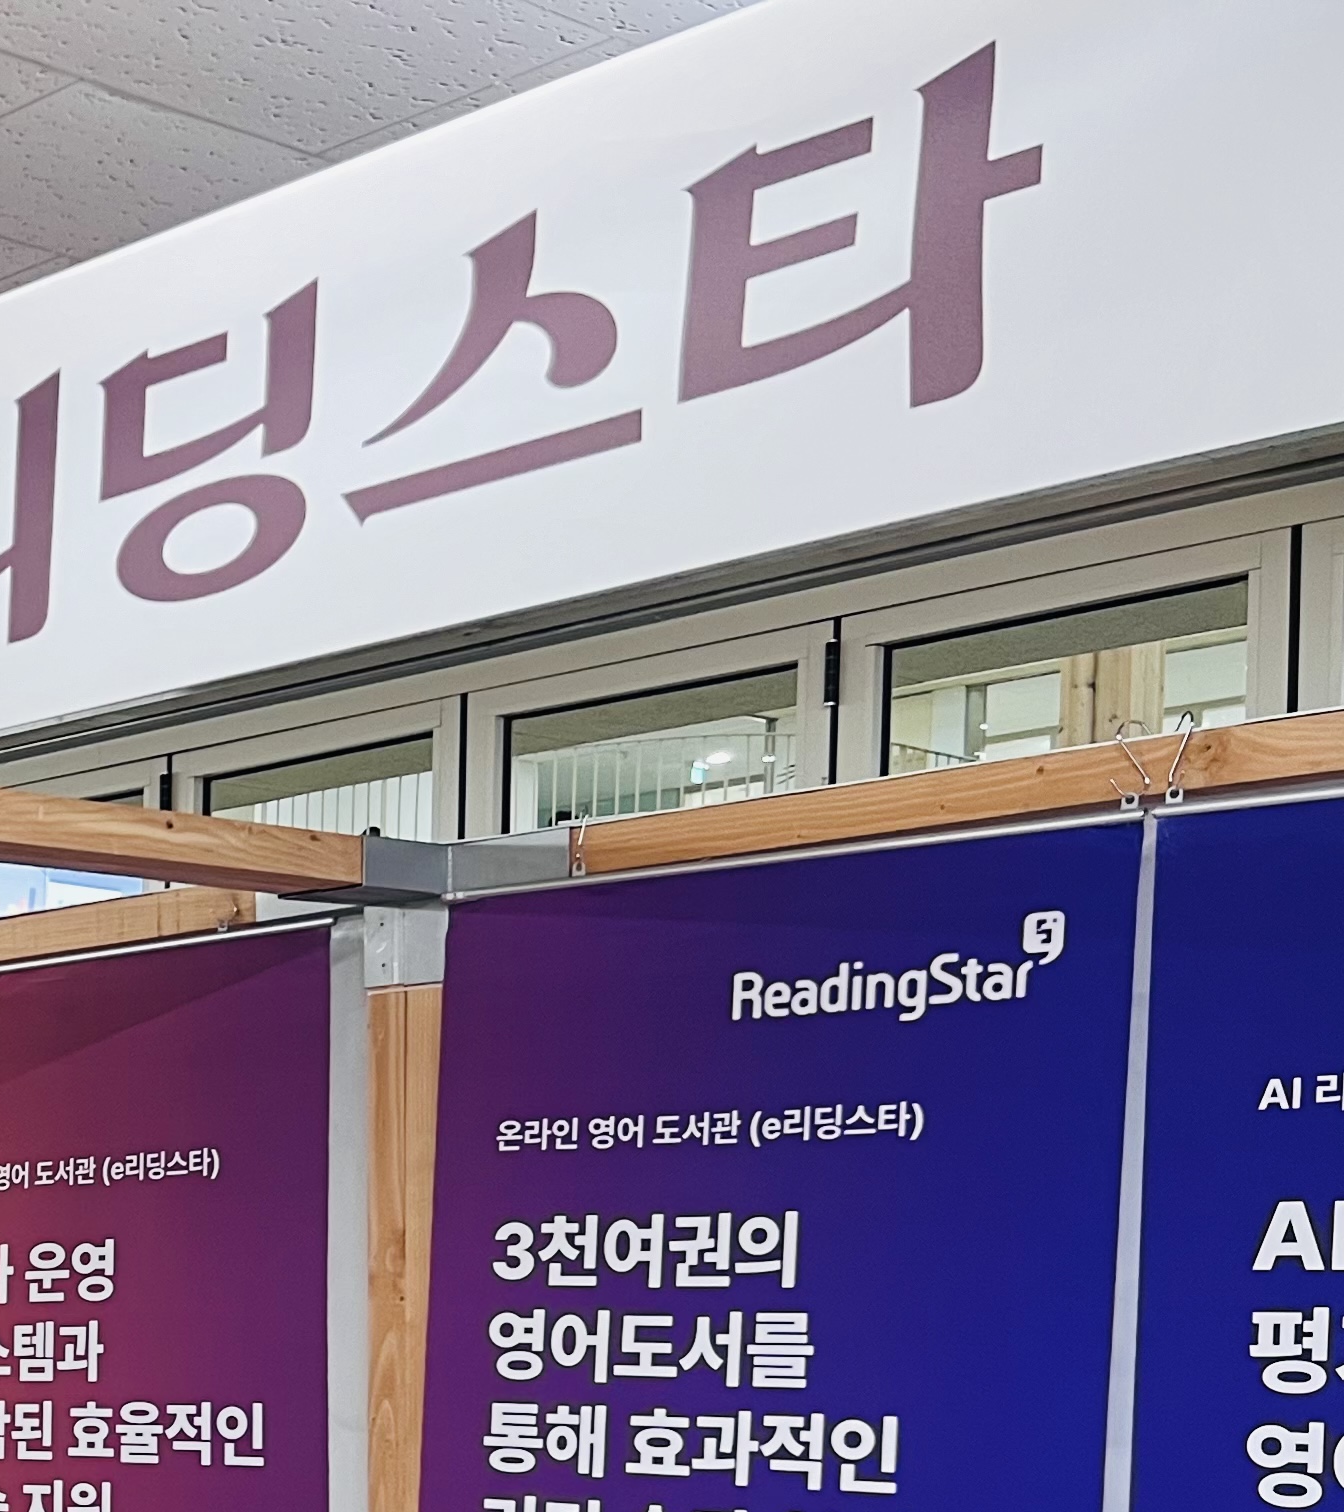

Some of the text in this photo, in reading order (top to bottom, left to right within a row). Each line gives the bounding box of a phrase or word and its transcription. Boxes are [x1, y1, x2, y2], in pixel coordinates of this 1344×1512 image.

[732, 953, 1034, 1022] ReadingStar
[495, 1101, 925, 1151] 온라인 영어 도서관 (e리딩스타)
[1258, 1075, 1301, 1111] AI
[34, 1156, 96, 1188] 도서관
[102, 1147, 220, 1186] (e리딩스타)
[24, 1239, 115, 1302] 운영
[493, 1211, 799, 1289] 3천여권의
[488, 1309, 814, 1389] 영어도서를
[1249, 1308, 1344, 1395] 평
[68, 1401, 265, 1467] 효율적인
[484, 1403, 899, 1494] 통해 효과적인
